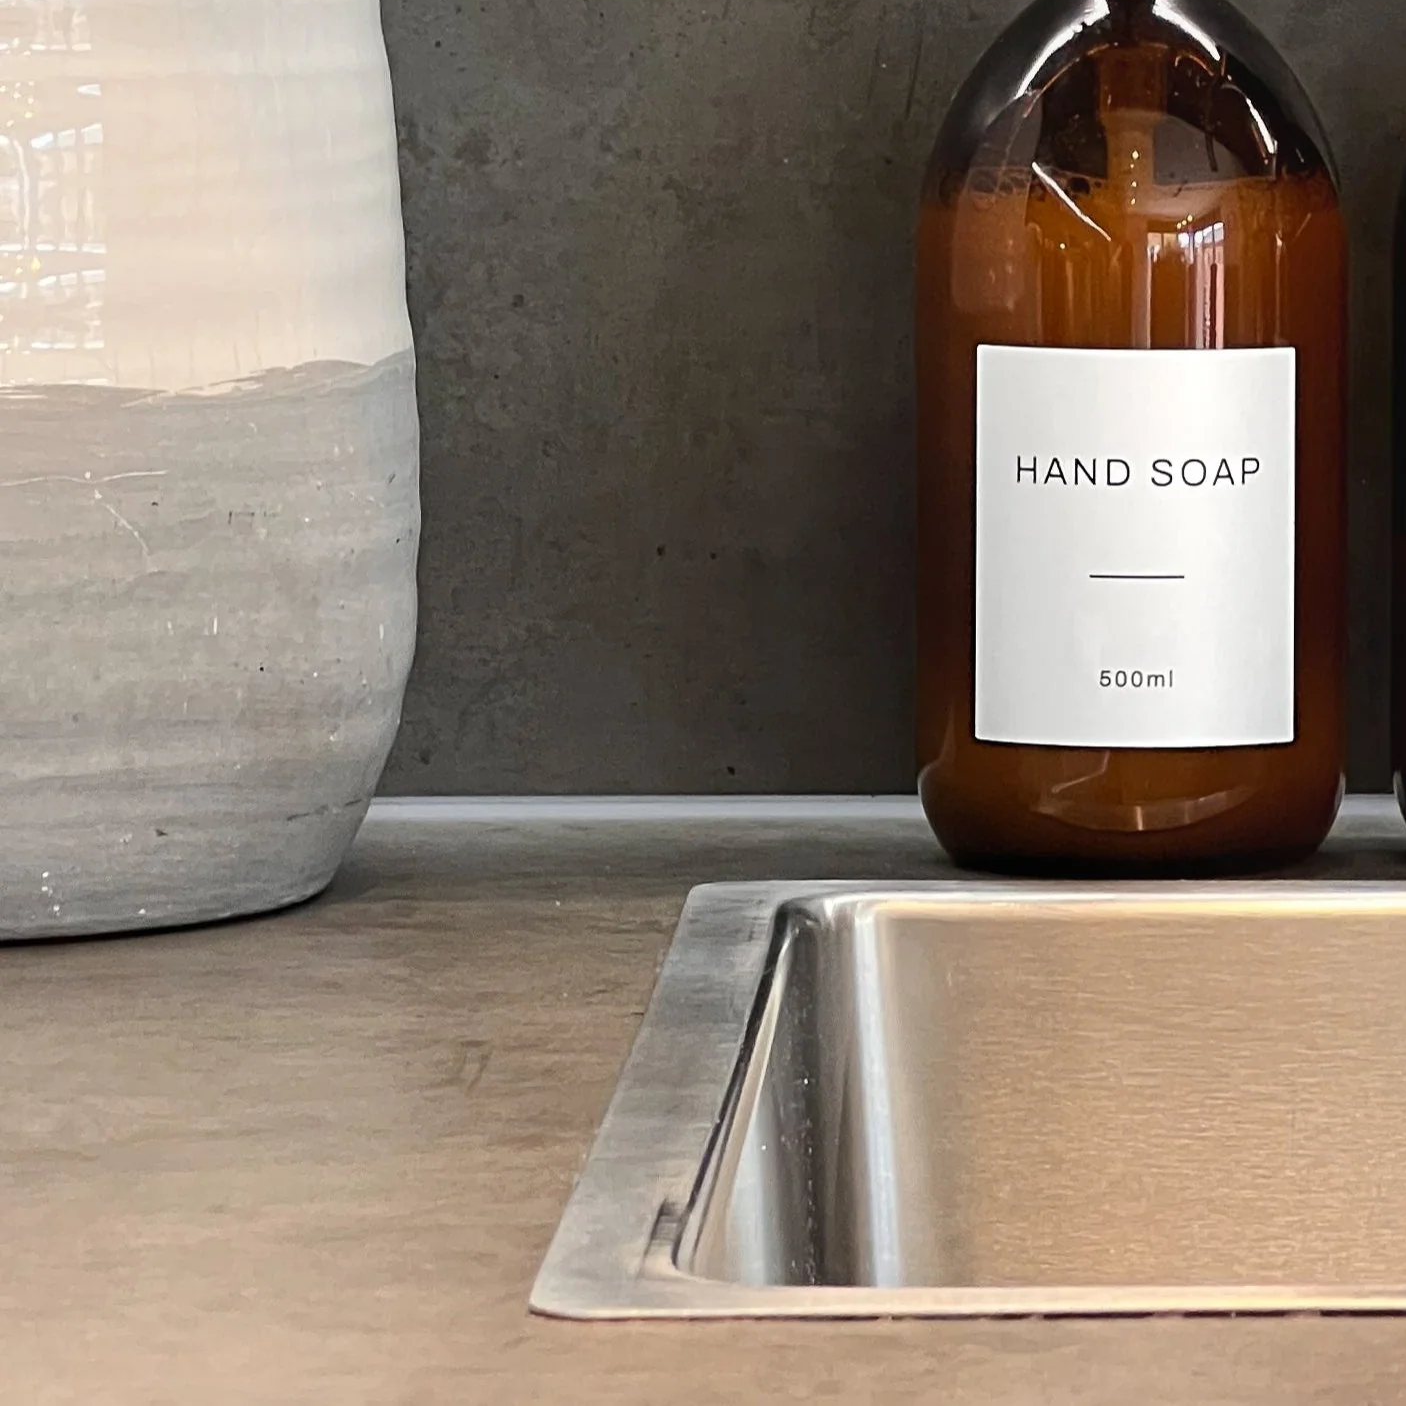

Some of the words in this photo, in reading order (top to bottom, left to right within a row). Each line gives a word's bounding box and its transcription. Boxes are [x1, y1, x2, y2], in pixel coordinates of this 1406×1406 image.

[1016, 455, 1130, 487] HAND
[1150, 457, 1260, 487] SOAP
[1099, 669, 1173, 688] 500ml
